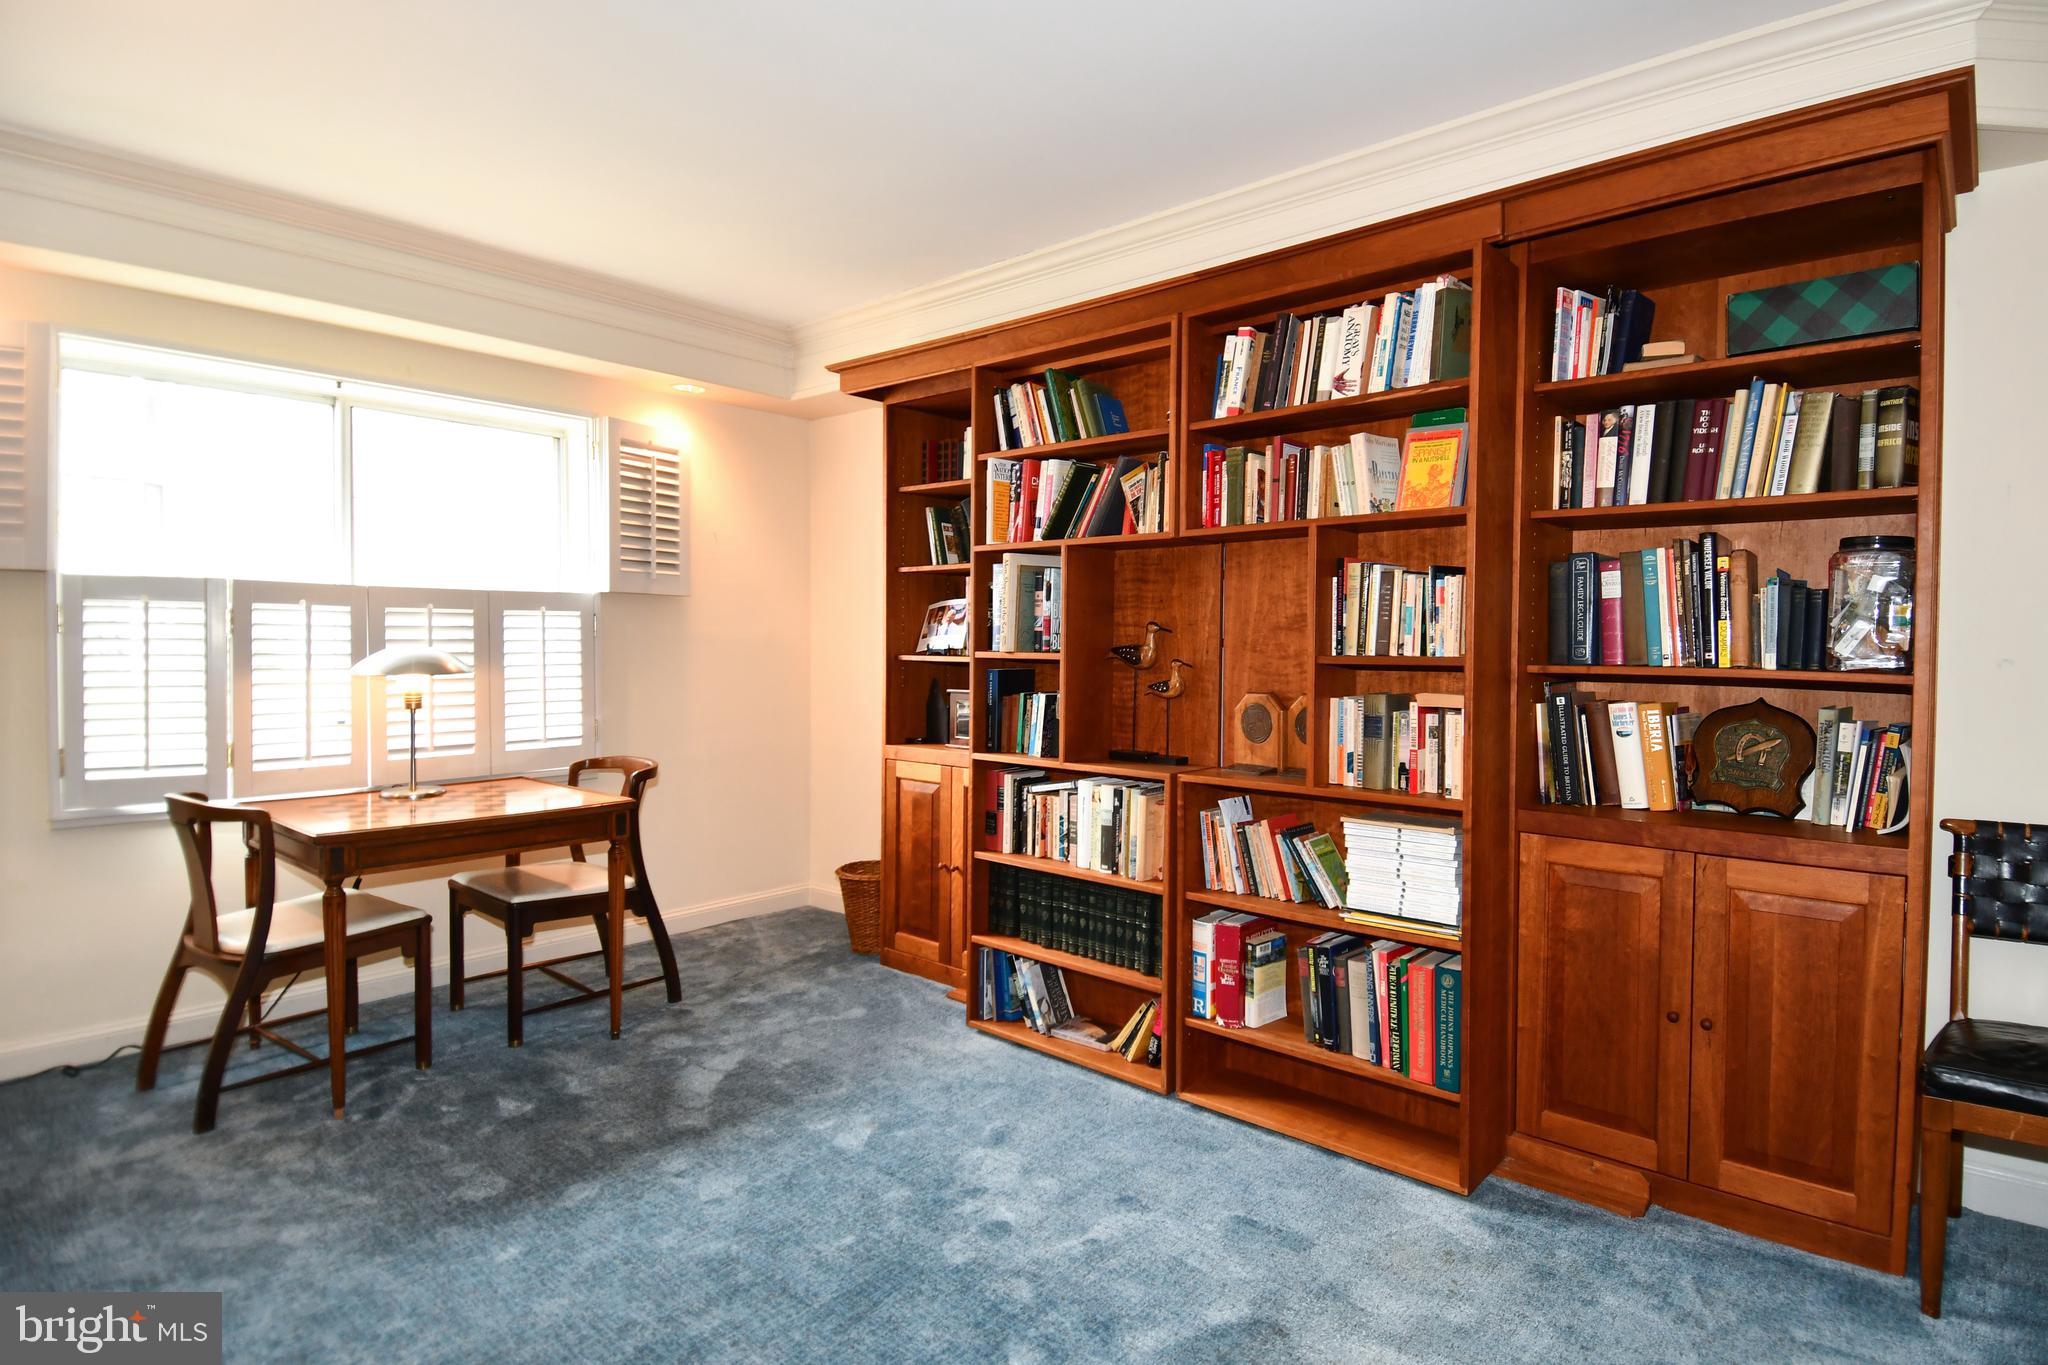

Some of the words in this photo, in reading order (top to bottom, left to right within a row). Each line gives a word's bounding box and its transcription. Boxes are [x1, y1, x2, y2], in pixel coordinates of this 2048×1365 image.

[1409, 310, 1419, 334] SIERRA
[1342, 316, 1356, 365] ANATOMY
[1351, 323, 1361, 356] GRAY'S
[1406, 335, 1416, 360] NEVADA
[1233, 366, 1242, 394] FRANCE
[1880, 398, 1904, 407] GUNTHER
[1784, 417, 1795, 435] RAGE
[1878, 423, 1902, 432] INSIDE
[1907, 420, 1918, 441] INS
[1414, 446, 1451, 458] SPANISH
[1619, 430, 1632, 456] 1776
[1783, 439, 1792, 454] BOB
[1878, 437, 1902, 447] AFRICA
[1424, 454, 1450, 463] NUTSHELL
[1776, 454, 1789, 492] WOODWARD
[1704, 538, 1712, 570] UNDERSEA
[1720, 572, 1728, 596] Veterans
[1720, 596, 1728, 619] Benefits
[1558, 704, 1567, 744] ILLUSTRATED
[1647, 710, 1664, 752] IBERIA
[1825, 720, 1834, 734] FAR
[1193, 998, 1206, 1014] R
[1390, 997, 1398, 1030] PARTICLE
[1392, 1031, 1400, 1070] LEDERMAN
